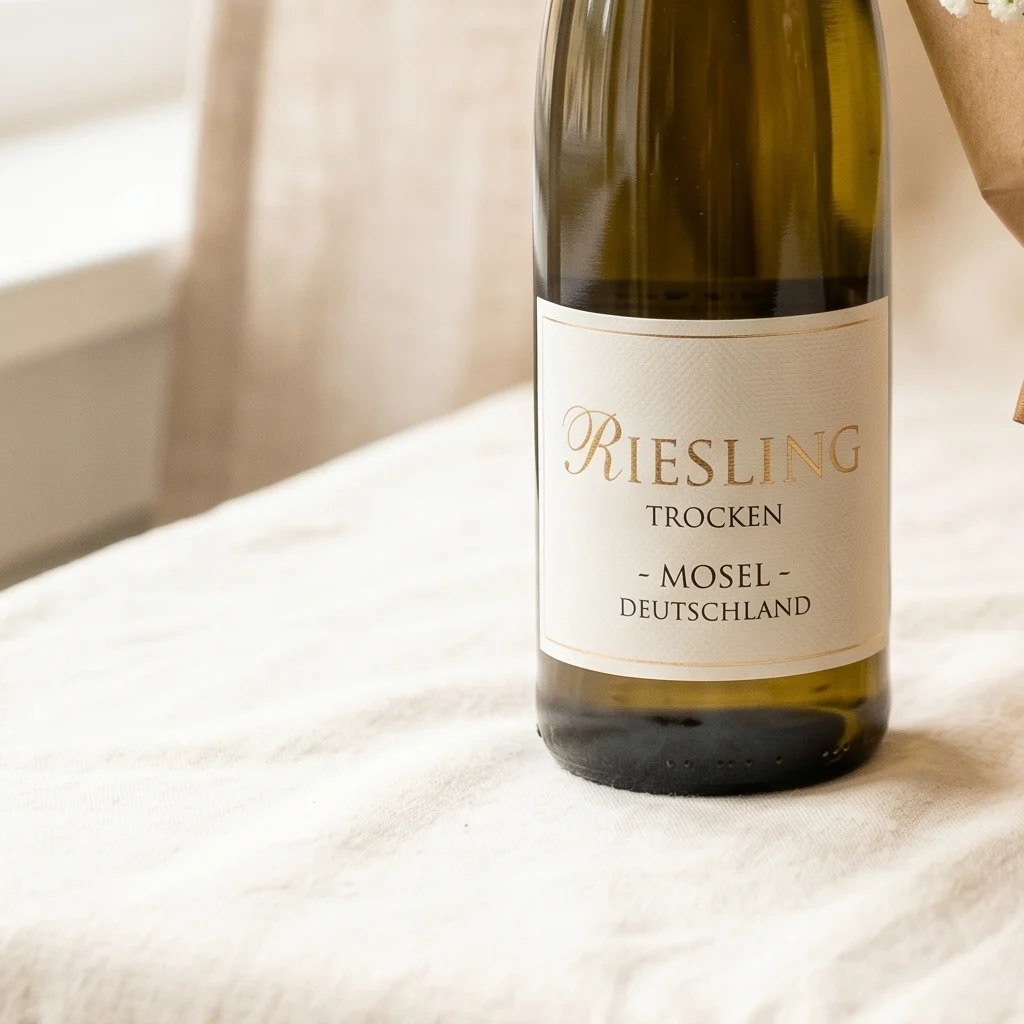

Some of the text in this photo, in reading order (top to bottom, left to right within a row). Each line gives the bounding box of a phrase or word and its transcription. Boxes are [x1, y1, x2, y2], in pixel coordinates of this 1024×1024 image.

[562, 405, 861, 487] RIESLING
[645, 503, 783, 529] TROCKEN
[660, 562, 771, 589] MOSEL
[619, 595, 811, 622] DEUTSCHLAND
